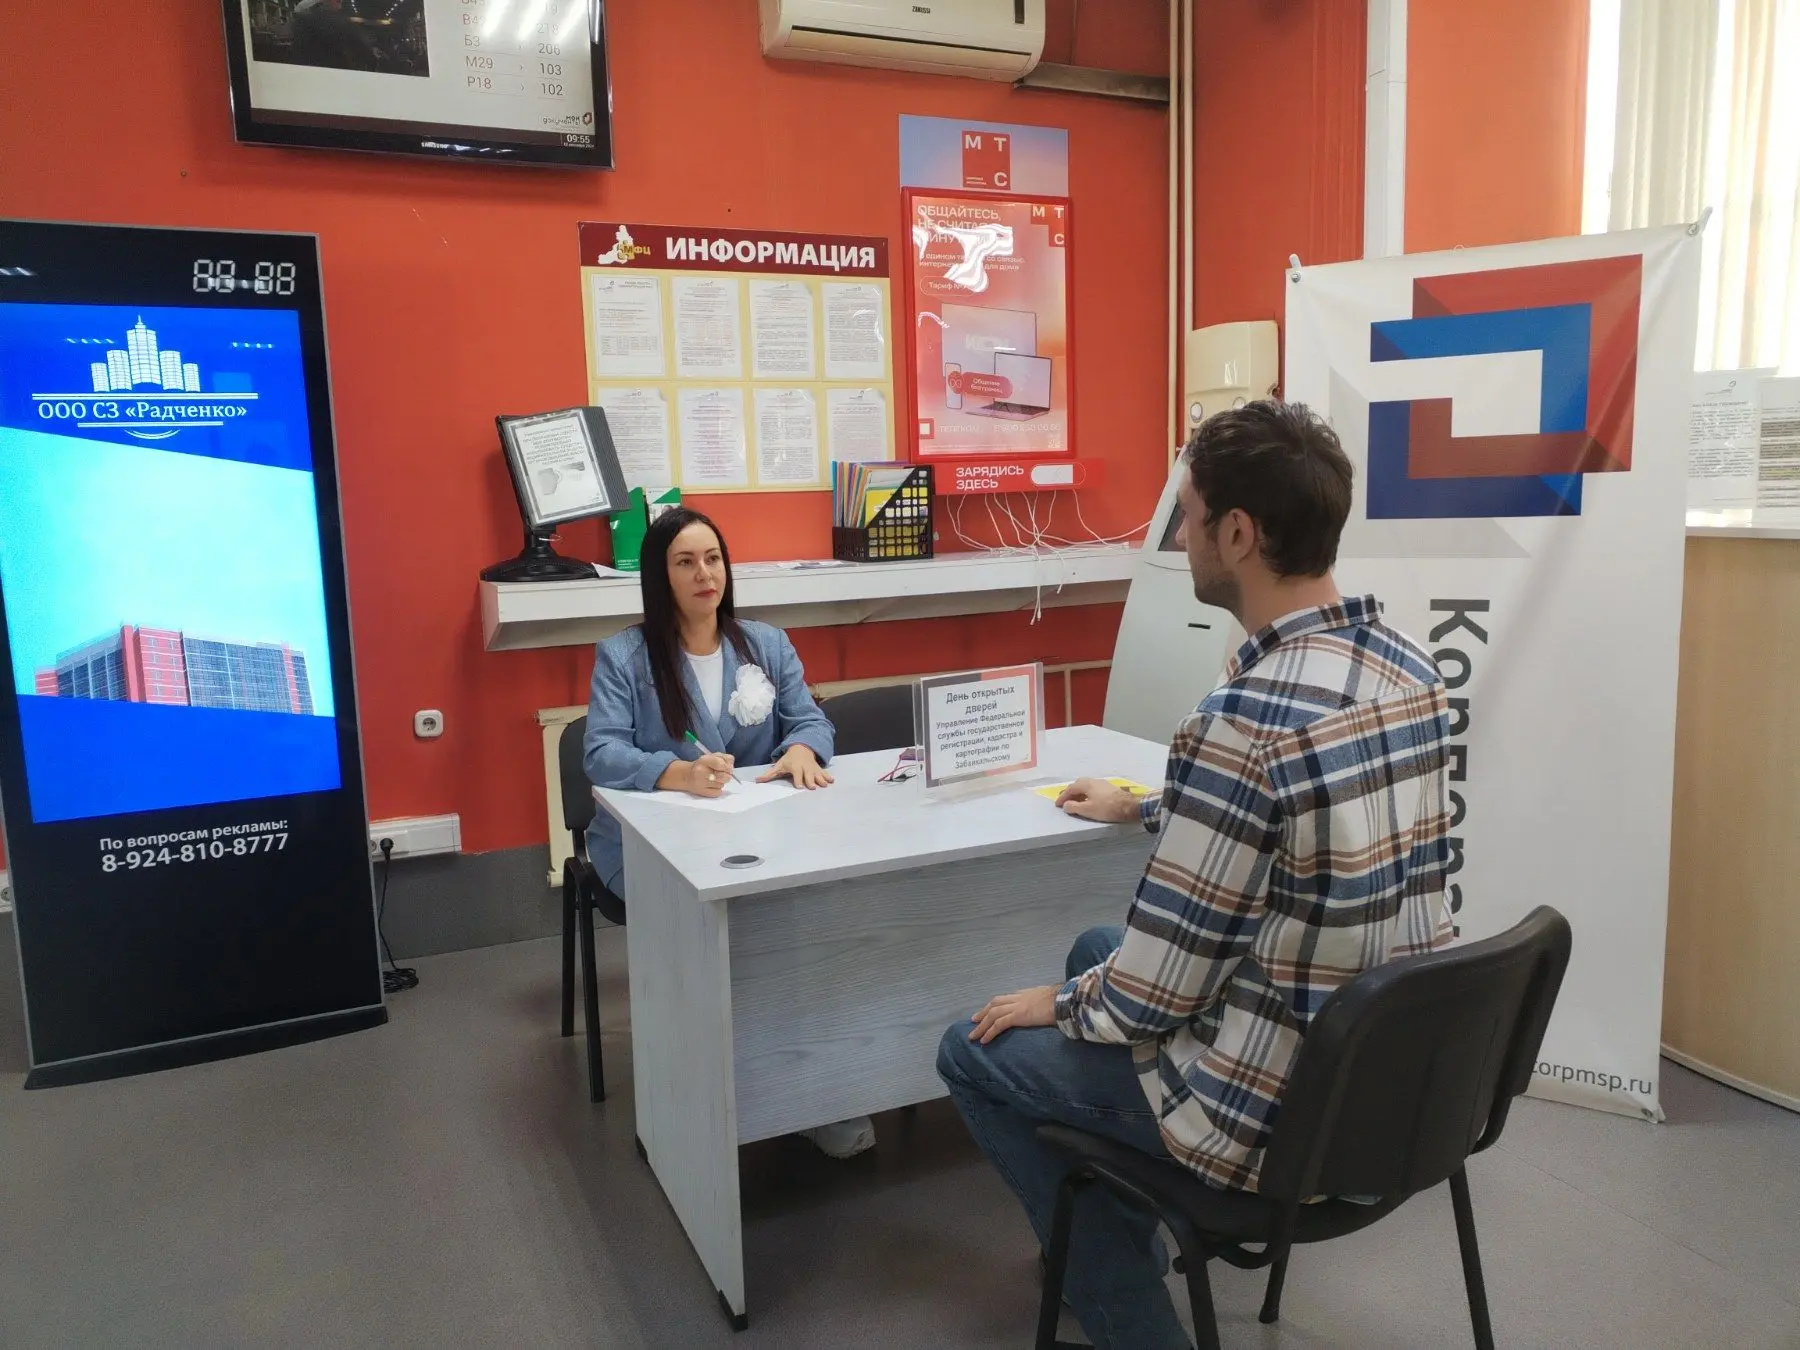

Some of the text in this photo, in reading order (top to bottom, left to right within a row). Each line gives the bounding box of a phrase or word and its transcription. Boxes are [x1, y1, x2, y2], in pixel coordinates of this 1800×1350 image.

[538, 43, 561, 55] 206
[465, 55, 563, 76] М29 103
[467, 75, 564, 96] Р18 102
[566, 134, 591, 144] 09:55
[917, 204, 1001, 221] ОБЩАЙТЕСЬ,
[665, 237, 875, 271] ИНФОРМАЦИЯ
[928, 281, 953, 291] Тариф
[38, 402, 247, 421] ООО СЗ «Радченко»
[955, 465, 1024, 478] ЗАРЯДИСЬ
[956, 478, 998, 491] ЗДЕСЬ
[946, 686, 1015, 704] День открытых
[965, 700, 998, 715] дверей
[936, 709, 1025, 730] Управление Федеральной
[937, 720, 1025, 740] службы государственной
[987, 731, 1017, 742] кадастра
[955, 745, 1000, 759] картографии
[955, 754, 1011, 769] Забайкальскому
[99, 820, 288, 851] По вопросам рекламы:
[101, 832, 289, 873] 8-924-810-8777
